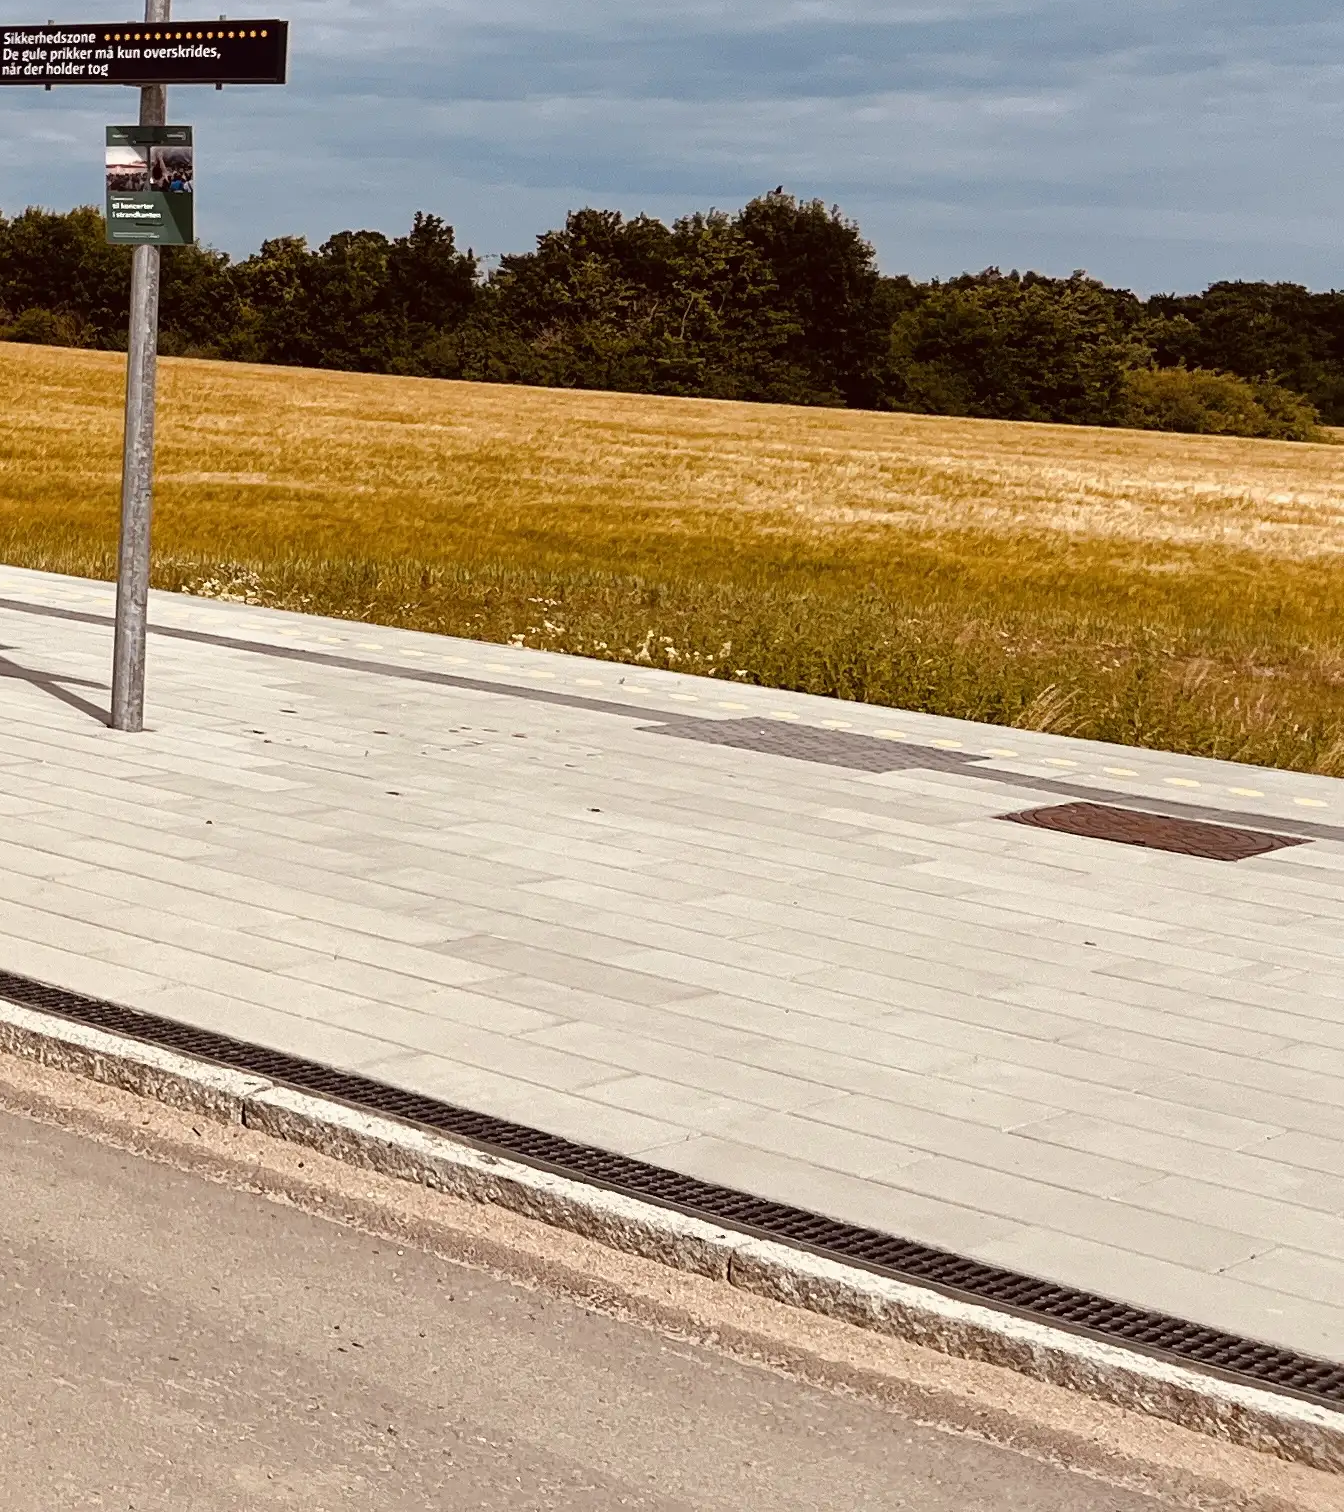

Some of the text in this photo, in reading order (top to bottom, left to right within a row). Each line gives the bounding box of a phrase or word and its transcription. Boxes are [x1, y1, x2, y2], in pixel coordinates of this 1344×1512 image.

[3, 31, 97, 45] Sikkerhedszone
[2, 44, 222, 63] De gule prikker må kun overskrides,
[1, 62, 109, 77] når der holder tog
